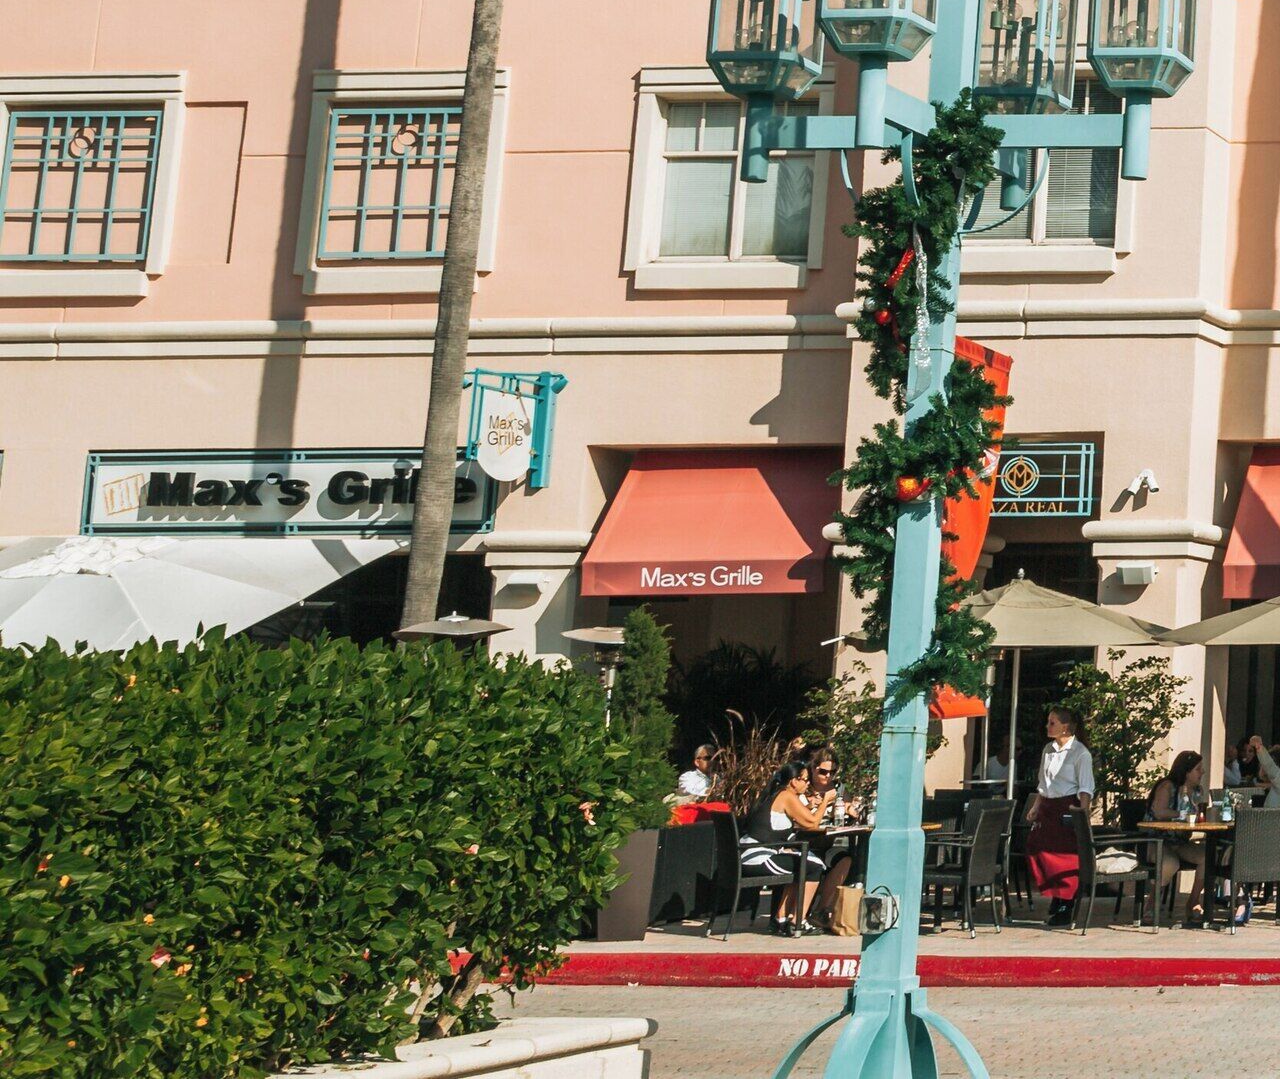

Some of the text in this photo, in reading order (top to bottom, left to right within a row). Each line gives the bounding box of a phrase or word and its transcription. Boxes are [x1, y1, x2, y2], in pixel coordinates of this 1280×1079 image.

[489, 415, 525, 431] Max's
[487, 431, 524, 446] Grille
[147, 467, 478, 507] Max's Grile
[1025, 501, 1068, 514] REAL
[641, 564, 763, 588] Max's Grille
[777, 958, 861, 977] NO PAR
